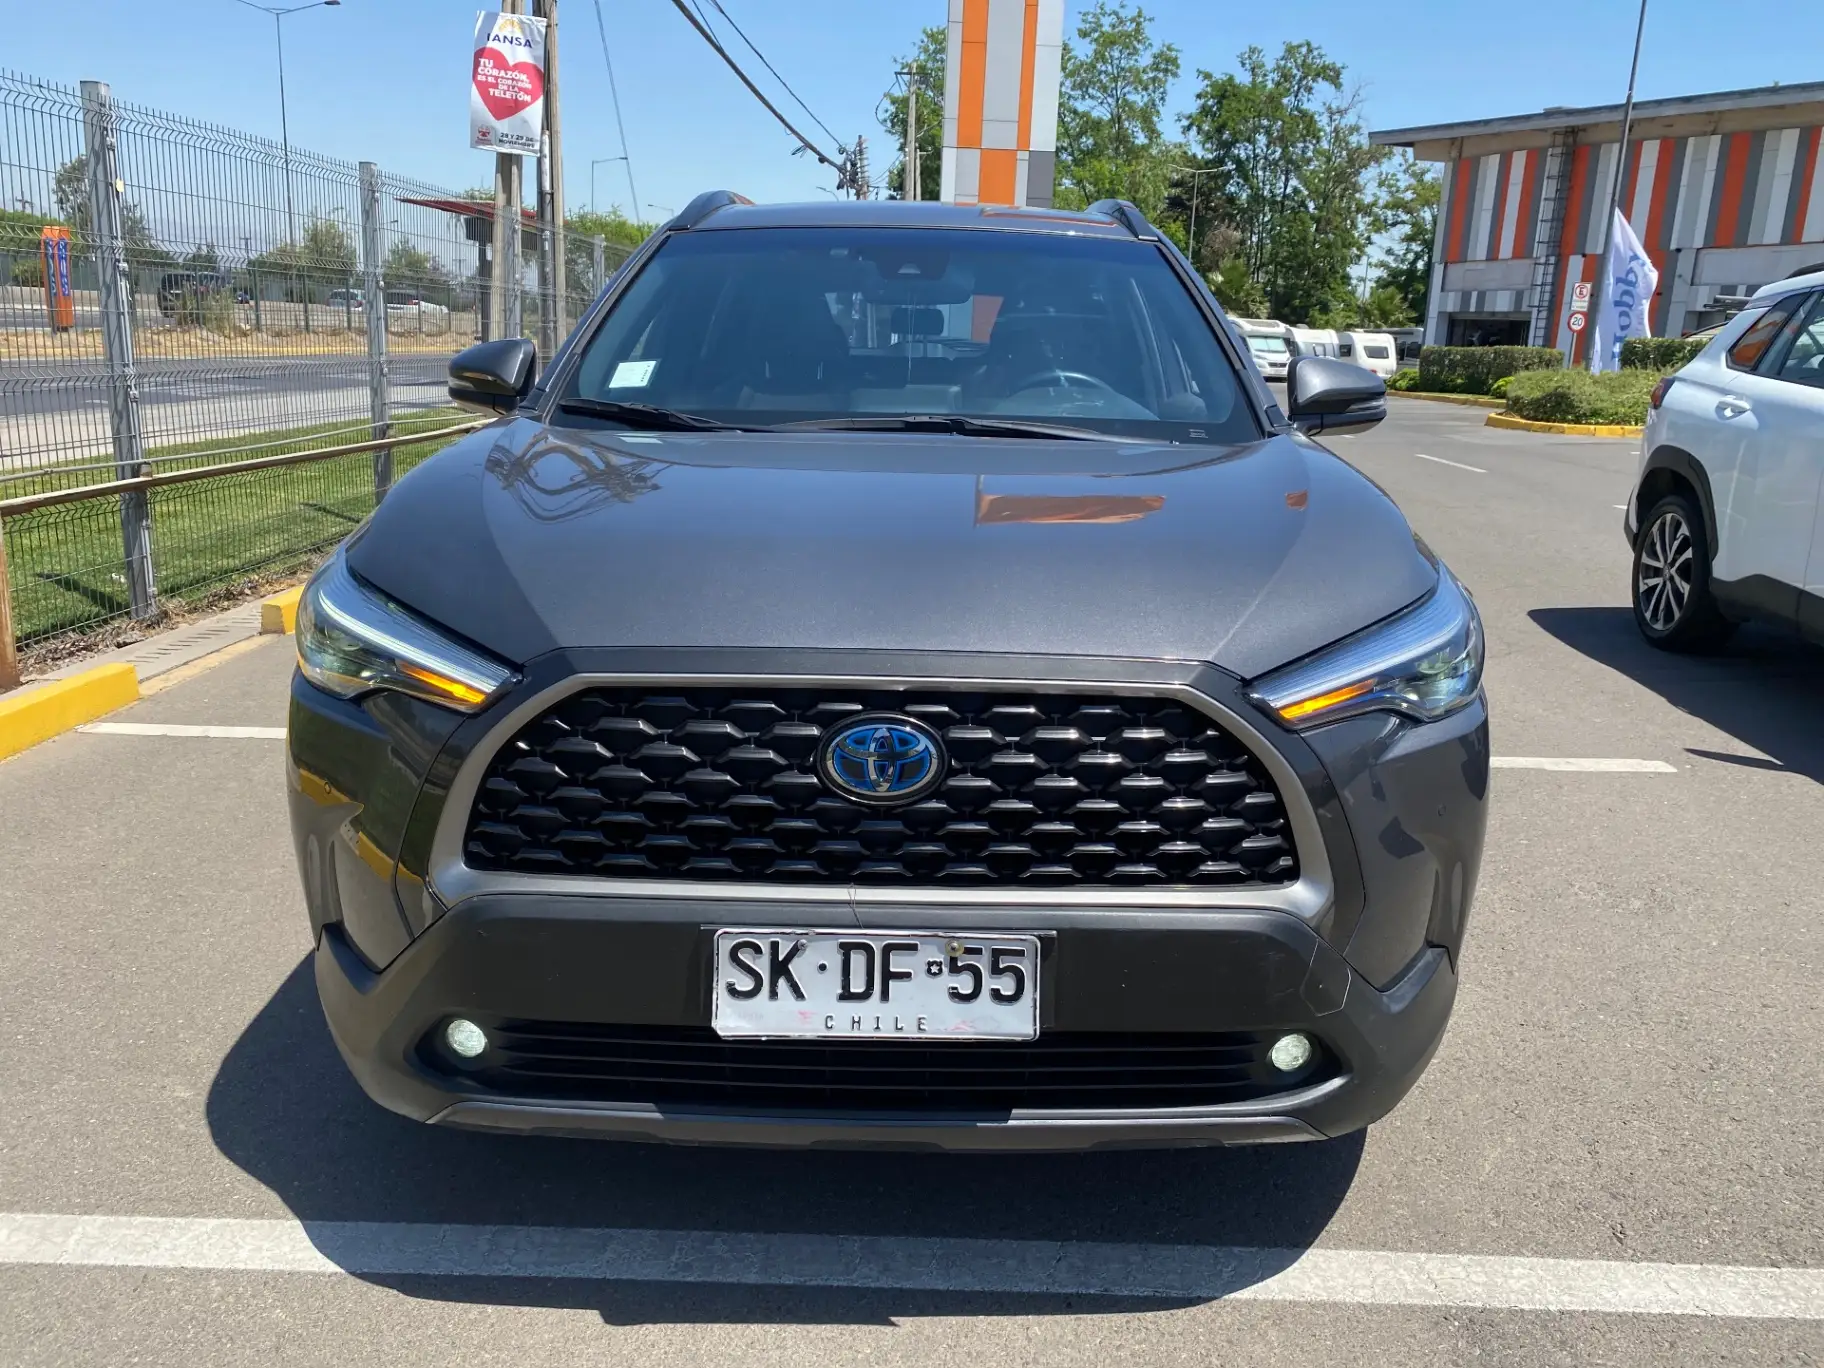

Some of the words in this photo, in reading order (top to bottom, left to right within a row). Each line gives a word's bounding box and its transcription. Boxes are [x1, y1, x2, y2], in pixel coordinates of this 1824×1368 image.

[487, 33, 532, 49] IANSA
[479, 58, 493, 68] TU
[488, 88, 532, 103] TELETÓN
[1572, 317, 1583, 326] 20
[824, 1014, 928, 1032] CHILE
